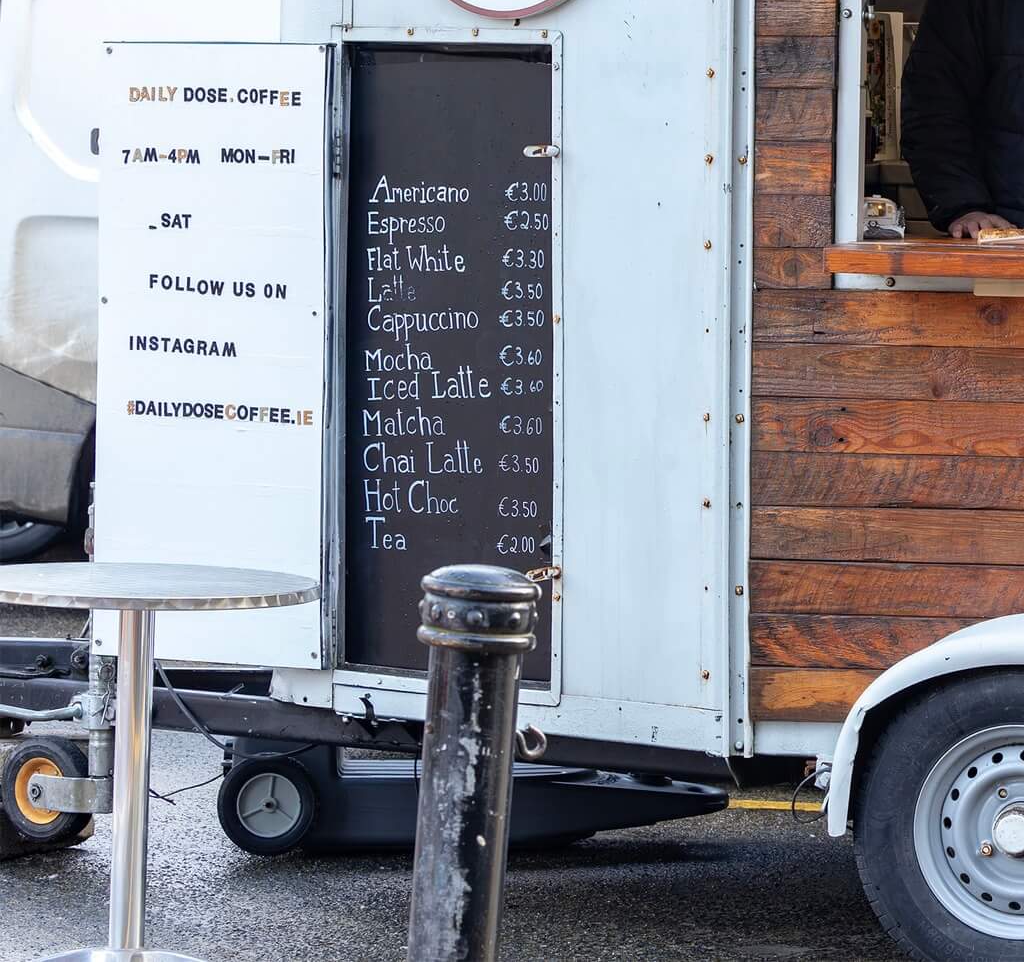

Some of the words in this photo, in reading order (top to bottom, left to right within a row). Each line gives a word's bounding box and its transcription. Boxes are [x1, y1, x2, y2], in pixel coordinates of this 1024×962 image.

[129, 86, 178, 103] DAILY
[369, 175, 470, 203] Americano
[505, 182, 547, 202] €3.00
[368, 211, 446, 245] Espresso
[504, 211, 549, 230] €2.50
[367, 247, 401, 271] Flat
[406, 244, 466, 272] White
[502, 249, 545, 268] €3.30
[149, 274, 225, 296] FOLLOW
[233, 282, 256, 298] US
[264, 283, 287, 299] ON
[368, 274, 416, 302] Latte
[501, 280, 543, 300] €3.50
[368, 305, 479, 341] Cappuccino
[499, 310, 545, 327] €3.50
[129, 335, 237, 357] INSTAGRAM
[364, 343, 434, 372] Mocha
[500, 345, 542, 366] €3.60
[367, 372, 420, 401] Iced
[431, 365, 492, 399] Latte
[362, 407, 446, 436] Matcha
[499, 415, 542, 435] €3.60
[363, 442, 416, 473] Chai
[426, 440, 483, 474] Latte
[499, 454, 540, 473] €3.50
[363, 479, 402, 513] Hot
[408, 480, 459, 514] Choc
[498, 497, 537, 518] €3.50
[365, 516, 407, 551] Tea
[496, 534, 535, 554] €2.00
